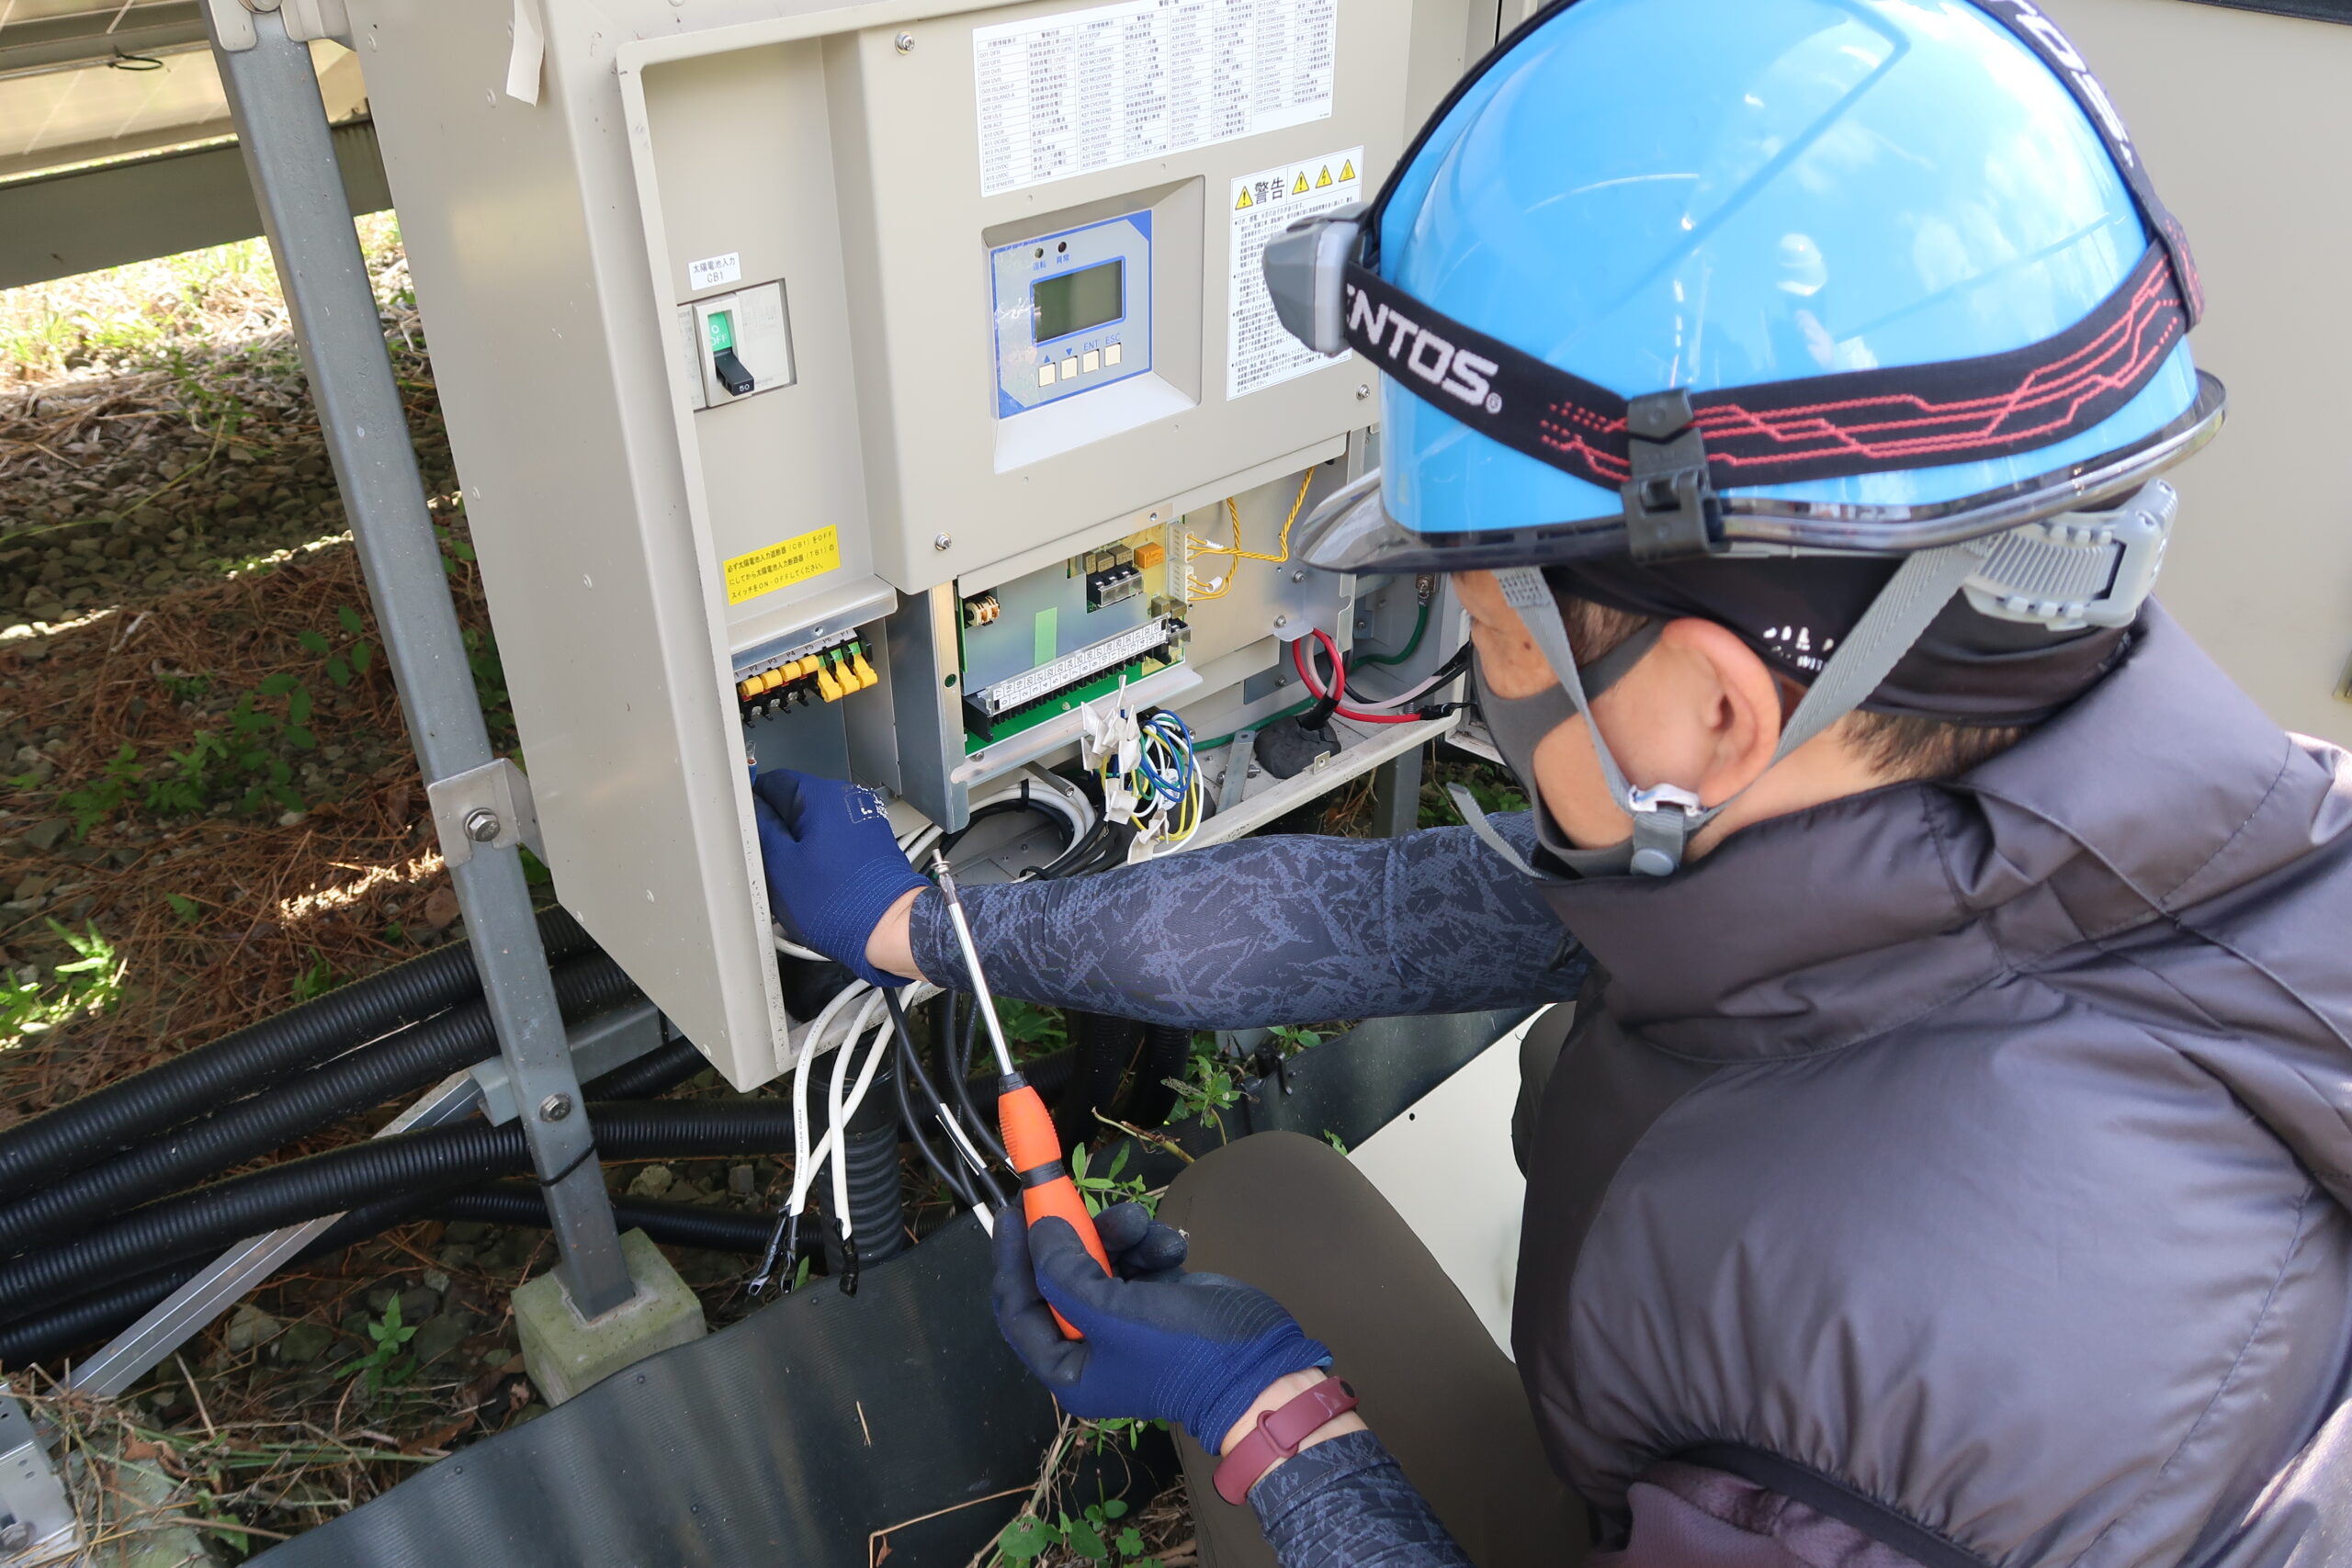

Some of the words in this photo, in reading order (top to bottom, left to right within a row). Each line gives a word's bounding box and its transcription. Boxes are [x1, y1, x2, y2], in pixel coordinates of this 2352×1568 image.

[1254, 176, 1285, 205] 警告
[693, 256, 736, 274] 太陽電池入力
[707, 274, 724, 284] CB1
[710, 334, 728, 346] OFF
[1105, 333, 1121, 344] ESC
[1084, 340, 1099, 351] ENT
[995, 690, 1001, 698] 17
[1006, 684, 1012, 694] 18
[1016, 680, 1023, 689] 19
[1027, 676, 1034, 685] 20
[1037, 672, 1044, 682] 21
[1047, 668, 1054, 677] 22
[1057, 663, 1064, 672] 23
[1068, 660, 1073, 669] 24
[1077, 656, 1083, 664] 25
[1087, 651, 1093, 660] 26
[1096, 648, 1102, 656] 27
[1106, 644, 1113, 652] 28
[1115, 639, 1122, 648] 29
[1125, 635, 1132, 644] 30
[1136, 632, 1141, 640] 31
[1144, 627, 1150, 637] 32
[1154, 623, 1159, 633] 33
